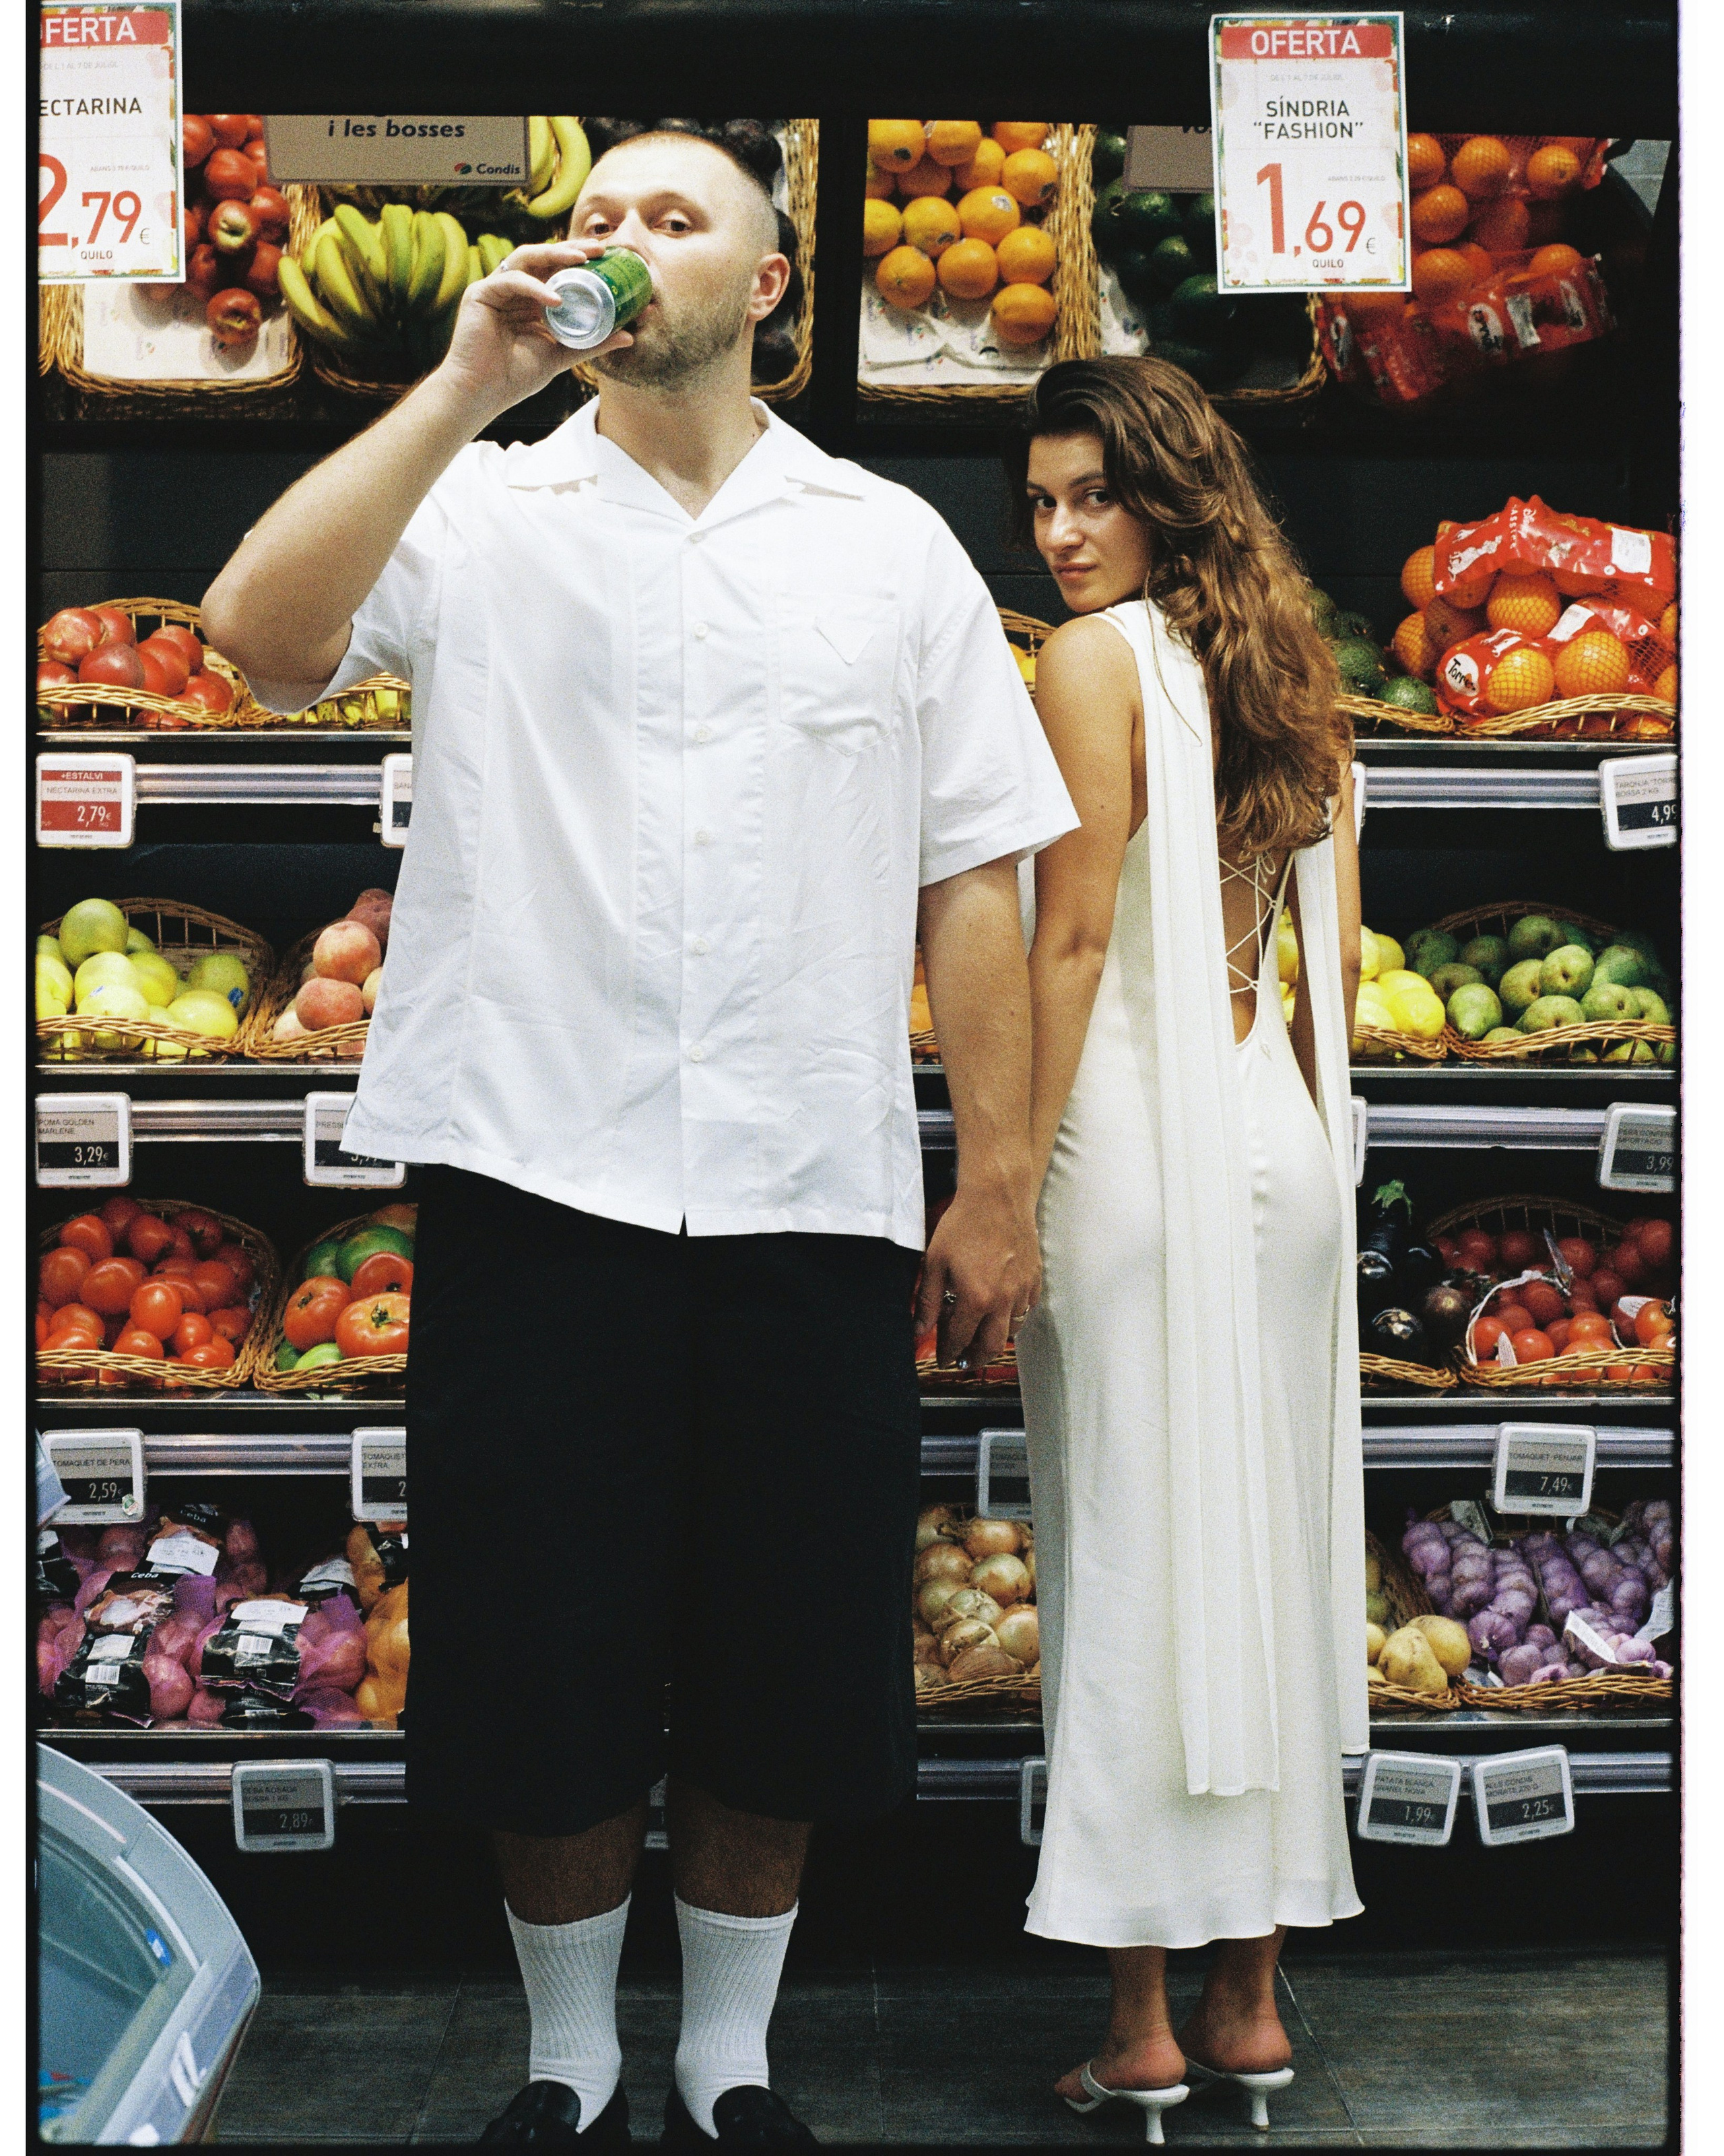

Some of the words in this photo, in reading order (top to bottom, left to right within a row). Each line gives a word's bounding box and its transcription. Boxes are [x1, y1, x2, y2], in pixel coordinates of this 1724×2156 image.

[40, 16, 137, 44] FERTA
[1251, 30, 1362, 56] OFERTA
[1266, 96, 1350, 117] SÍNDRIA
[328, 121, 335, 137] i
[344, 119, 377, 137] les
[386, 119, 466, 137] bosses
[476, 163, 521, 175] Condis
[80, 250, 113, 260] QUILO
[1313, 259, 1344, 269] QUILO
[63, 1118, 94, 1126] GOLDEN
[131, 1571, 160, 1579] Ceba
